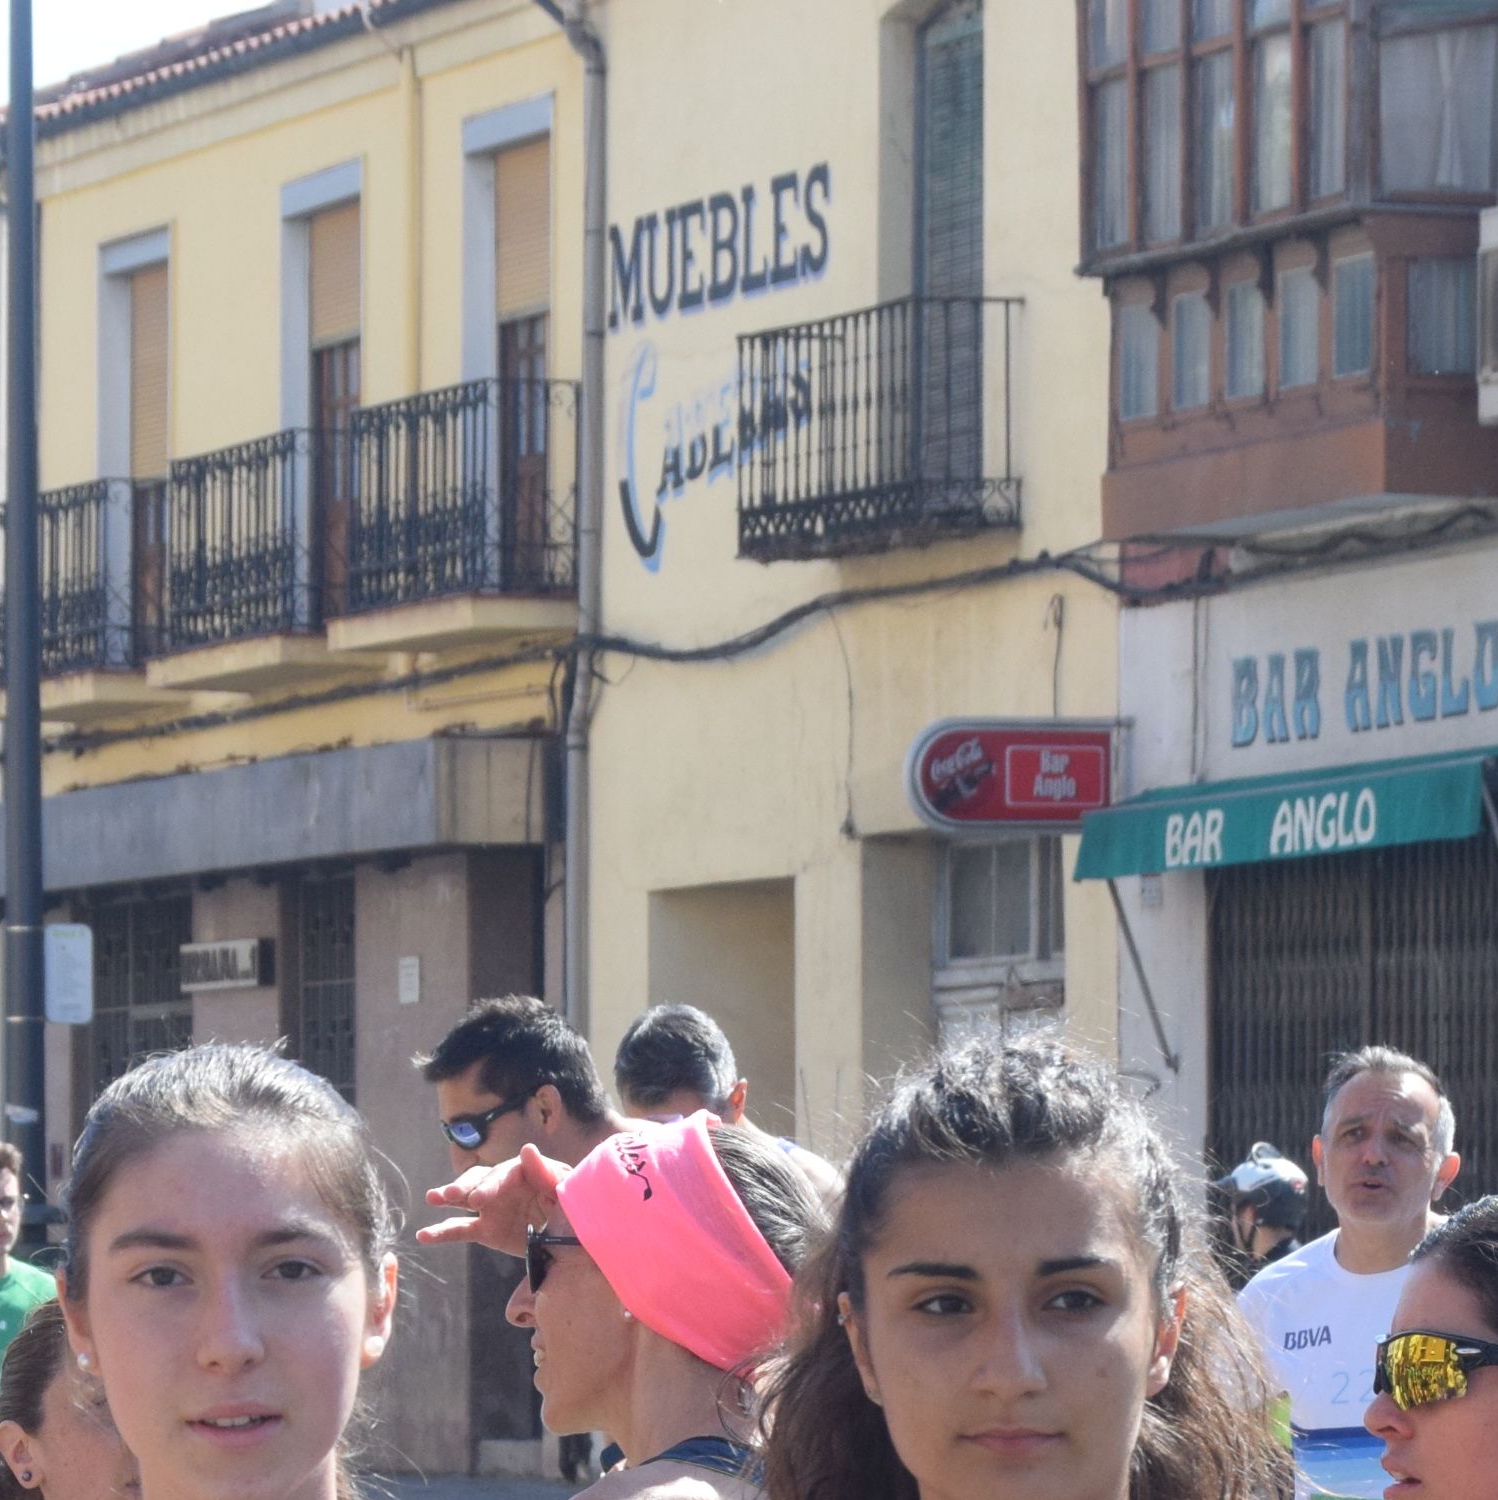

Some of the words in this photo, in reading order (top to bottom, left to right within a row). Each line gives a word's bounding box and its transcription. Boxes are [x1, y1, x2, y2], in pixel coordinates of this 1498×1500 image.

[608, 161, 832, 331] MUEBLES
[1231, 647, 1321, 748] BAR
[1033, 773, 1077, 801] Anglo
[1040, 749, 1070, 773] Bar
[1165, 808, 1224, 867] BAR
[1269, 787, 1377, 855] ANGLO
[1284, 1324, 1332, 1351] BBVA
